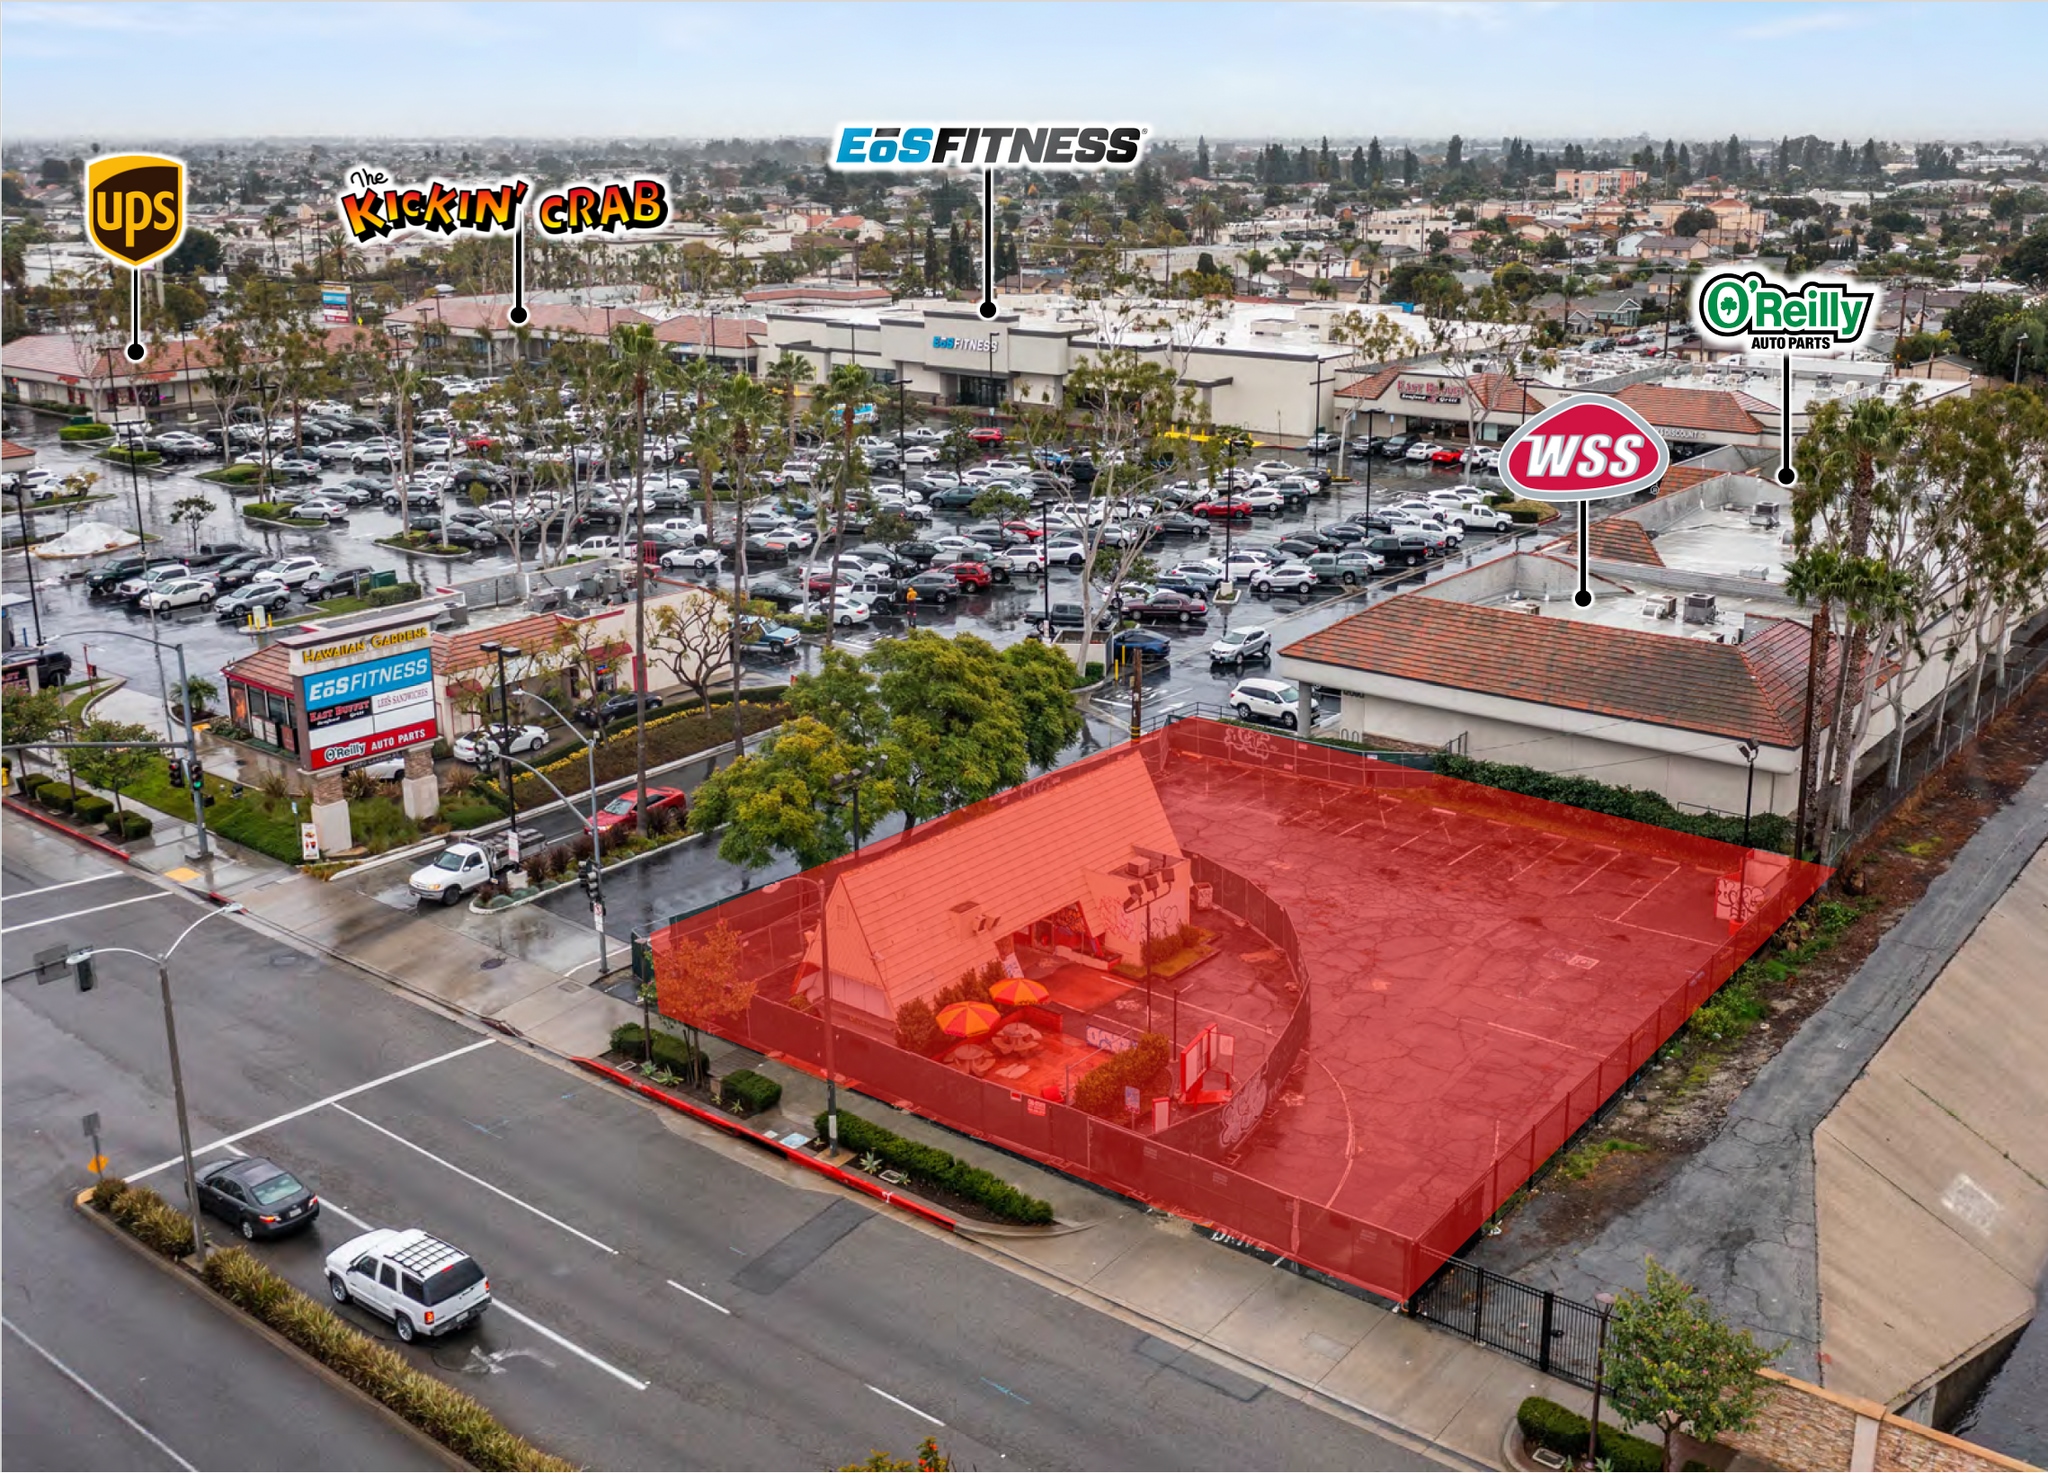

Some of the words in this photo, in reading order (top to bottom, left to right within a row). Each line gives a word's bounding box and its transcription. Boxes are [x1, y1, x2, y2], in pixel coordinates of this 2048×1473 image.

[1664, 428, 1699, 439] DISCOUNT
[302, 641, 366, 664] HAWAIIAN
[371, 627, 428, 648] GARDENS
[309, 709, 333, 723] EAST
[335, 700, 370, 716] BUFFET
[324, 742, 366, 761] O'Reilly
[371, 737, 394, 751] AUTO
[398, 729, 426, 744] PARTS
